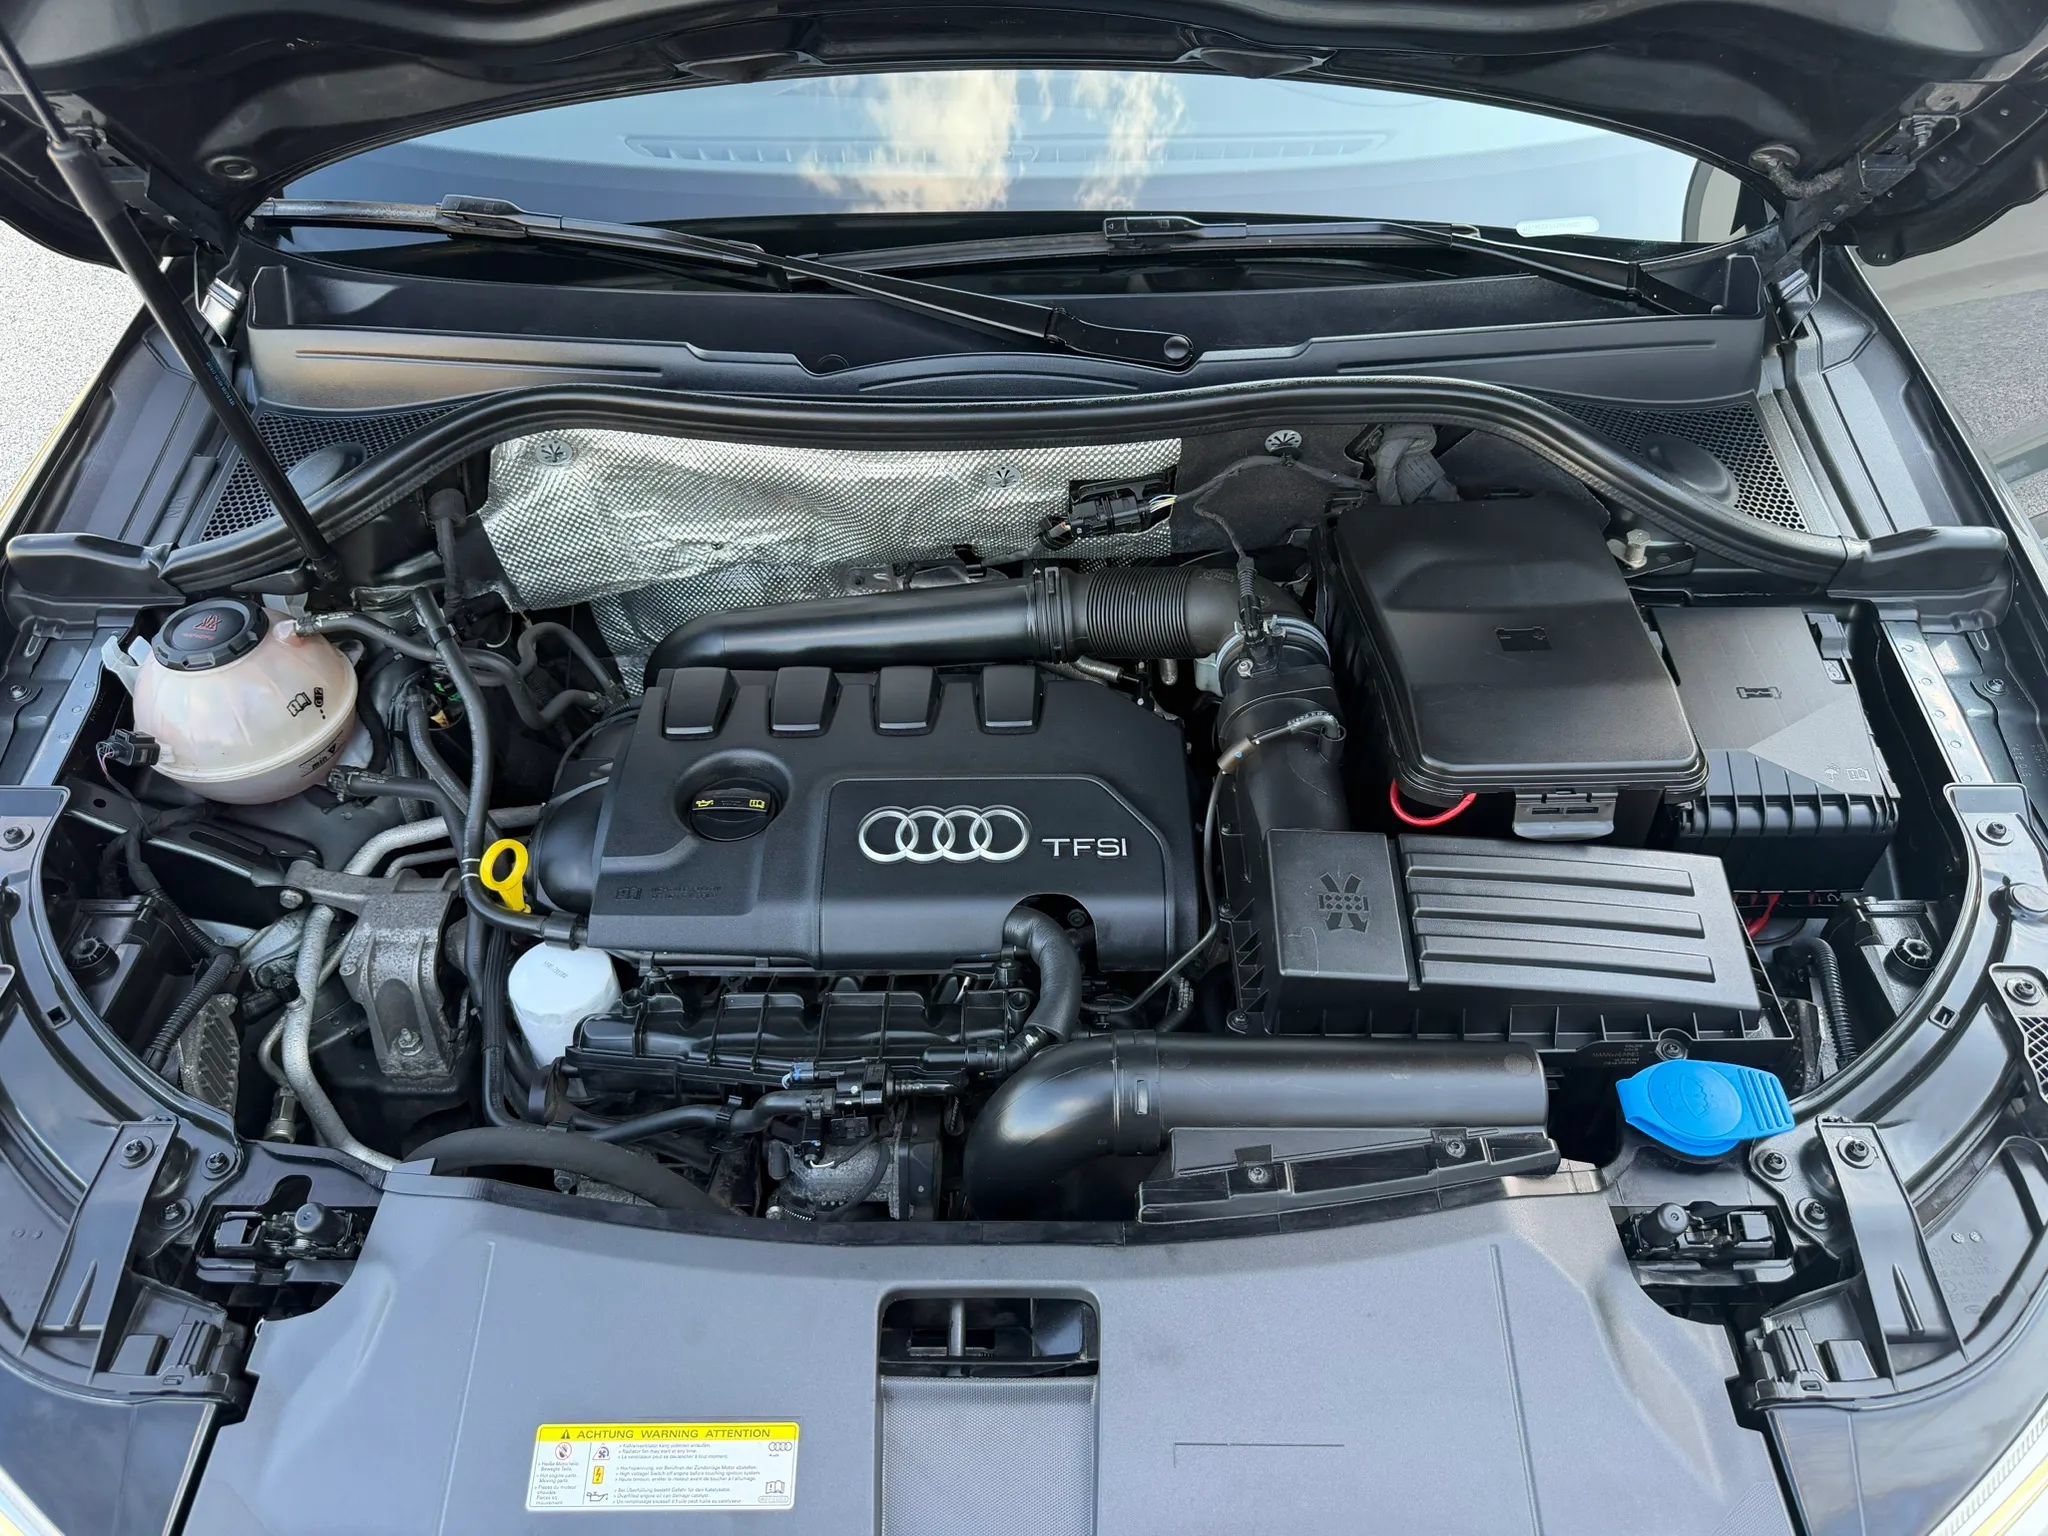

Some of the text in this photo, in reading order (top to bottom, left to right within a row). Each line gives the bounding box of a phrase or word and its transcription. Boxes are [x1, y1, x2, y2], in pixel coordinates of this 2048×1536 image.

[312, 756, 328, 770] min
[1042, 838, 1127, 857] TFSI
[577, 1429, 771, 1438] ACHTUNG WARNING ATTENTION
